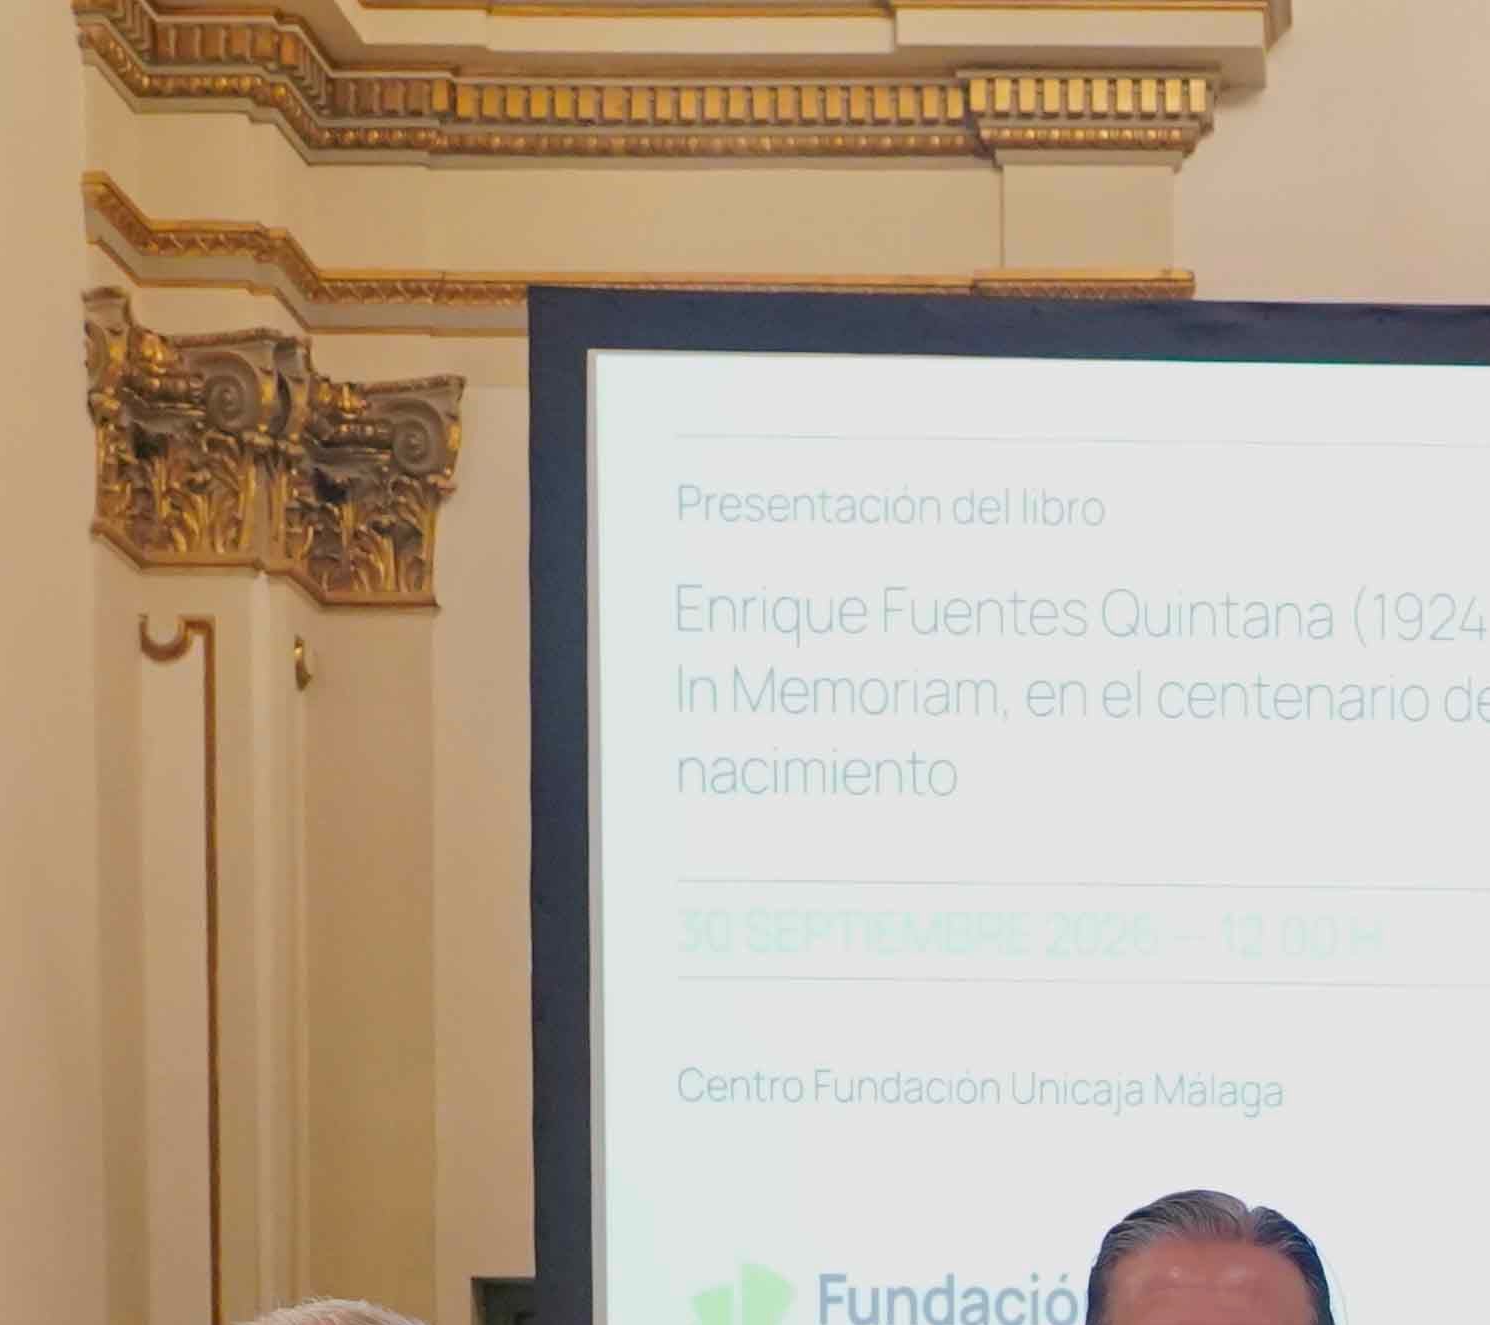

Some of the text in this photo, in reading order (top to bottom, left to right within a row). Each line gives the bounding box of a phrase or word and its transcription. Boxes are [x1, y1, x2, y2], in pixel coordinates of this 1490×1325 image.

[677, 483, 1106, 527] Presentación del libro
[677, 584, 868, 648] Enrique
[883, 587, 1089, 638] Fuentes
[1102, 588, 1335, 641] Quintana
[677, 665, 718, 714] In
[734, 666, 1008, 719] Memoriam,
[1026, 681, 1087, 718] en
[1102, 670, 1142, 718] el
[1158, 673, 1430, 722] centenario
[678, 748, 958, 797] nacimiento
[678, 1067, 1285, 1120] Centro Fundación Unicaja Málaga
